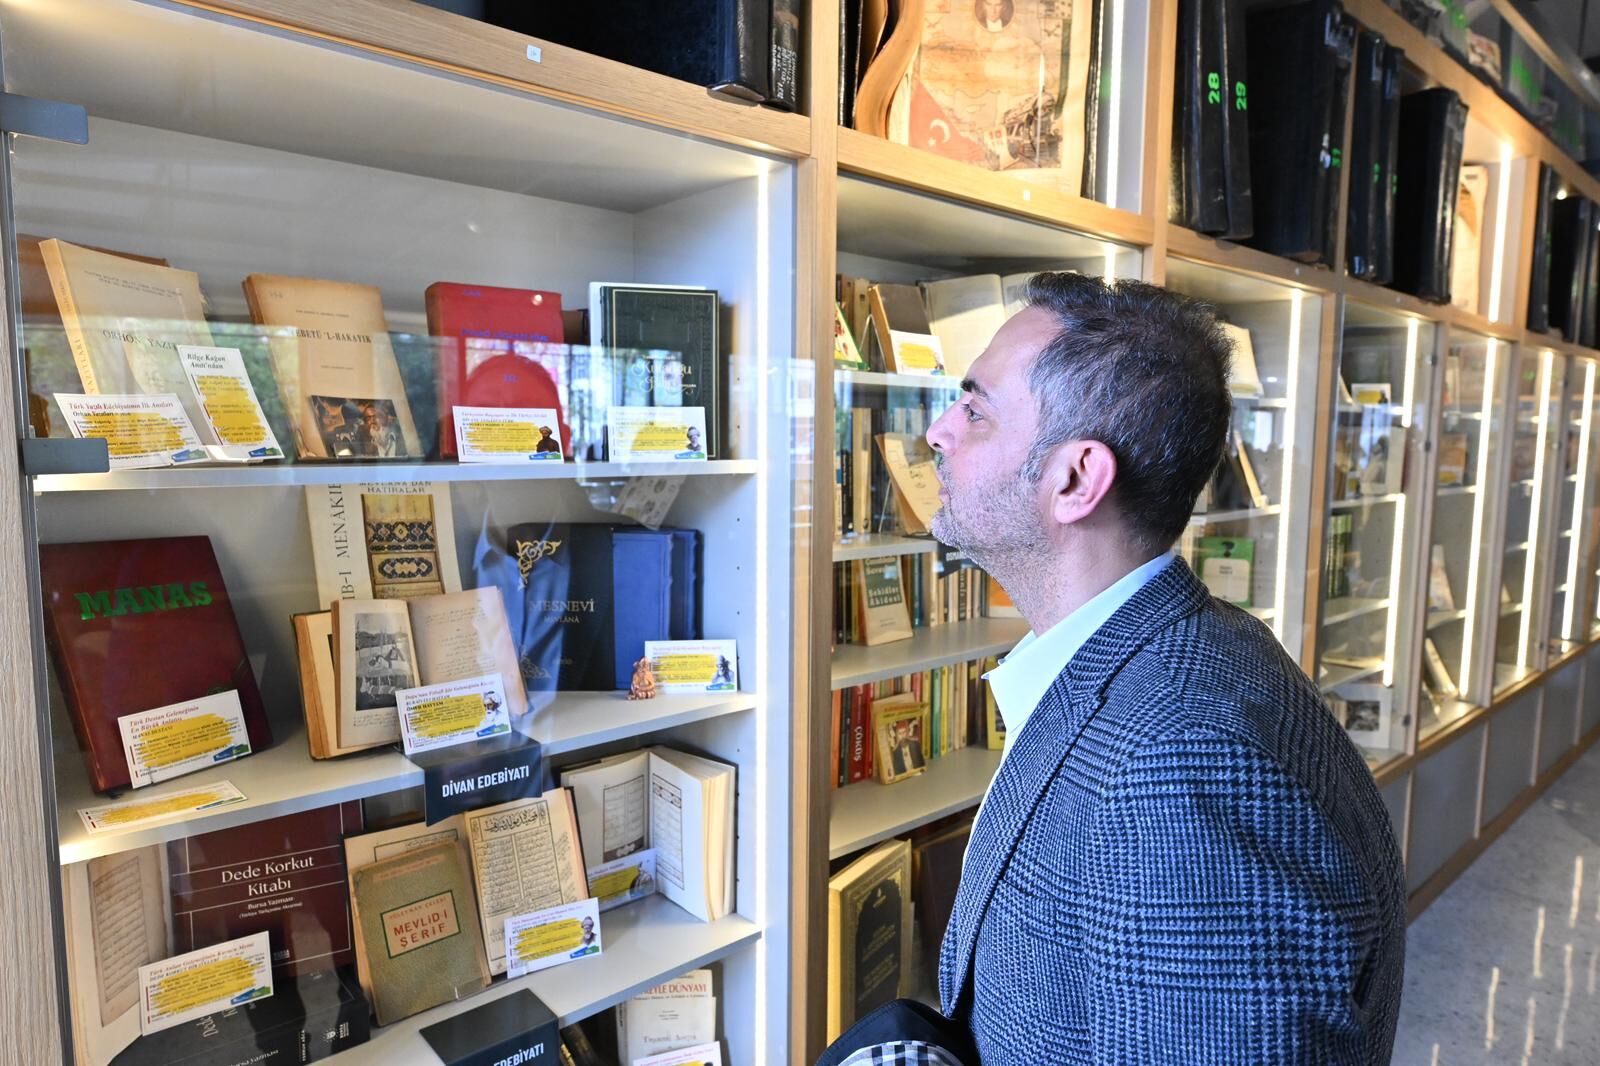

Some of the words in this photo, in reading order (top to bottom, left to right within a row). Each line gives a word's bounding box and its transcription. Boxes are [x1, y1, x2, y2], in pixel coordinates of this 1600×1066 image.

[1208, 72, 1220, 104] 28
[1235, 81, 1247, 110] 29
[74, 581, 213, 620] MANAS
[529, 598, 595, 612] MESNEVİ
[442, 778, 475, 798] DİVAN
[477, 765, 530, 789] EDEBİYATI
[221, 864, 260, 883] Dede
[265, 856, 315, 875] Korkut
[248, 877, 291, 896] Kitabı
